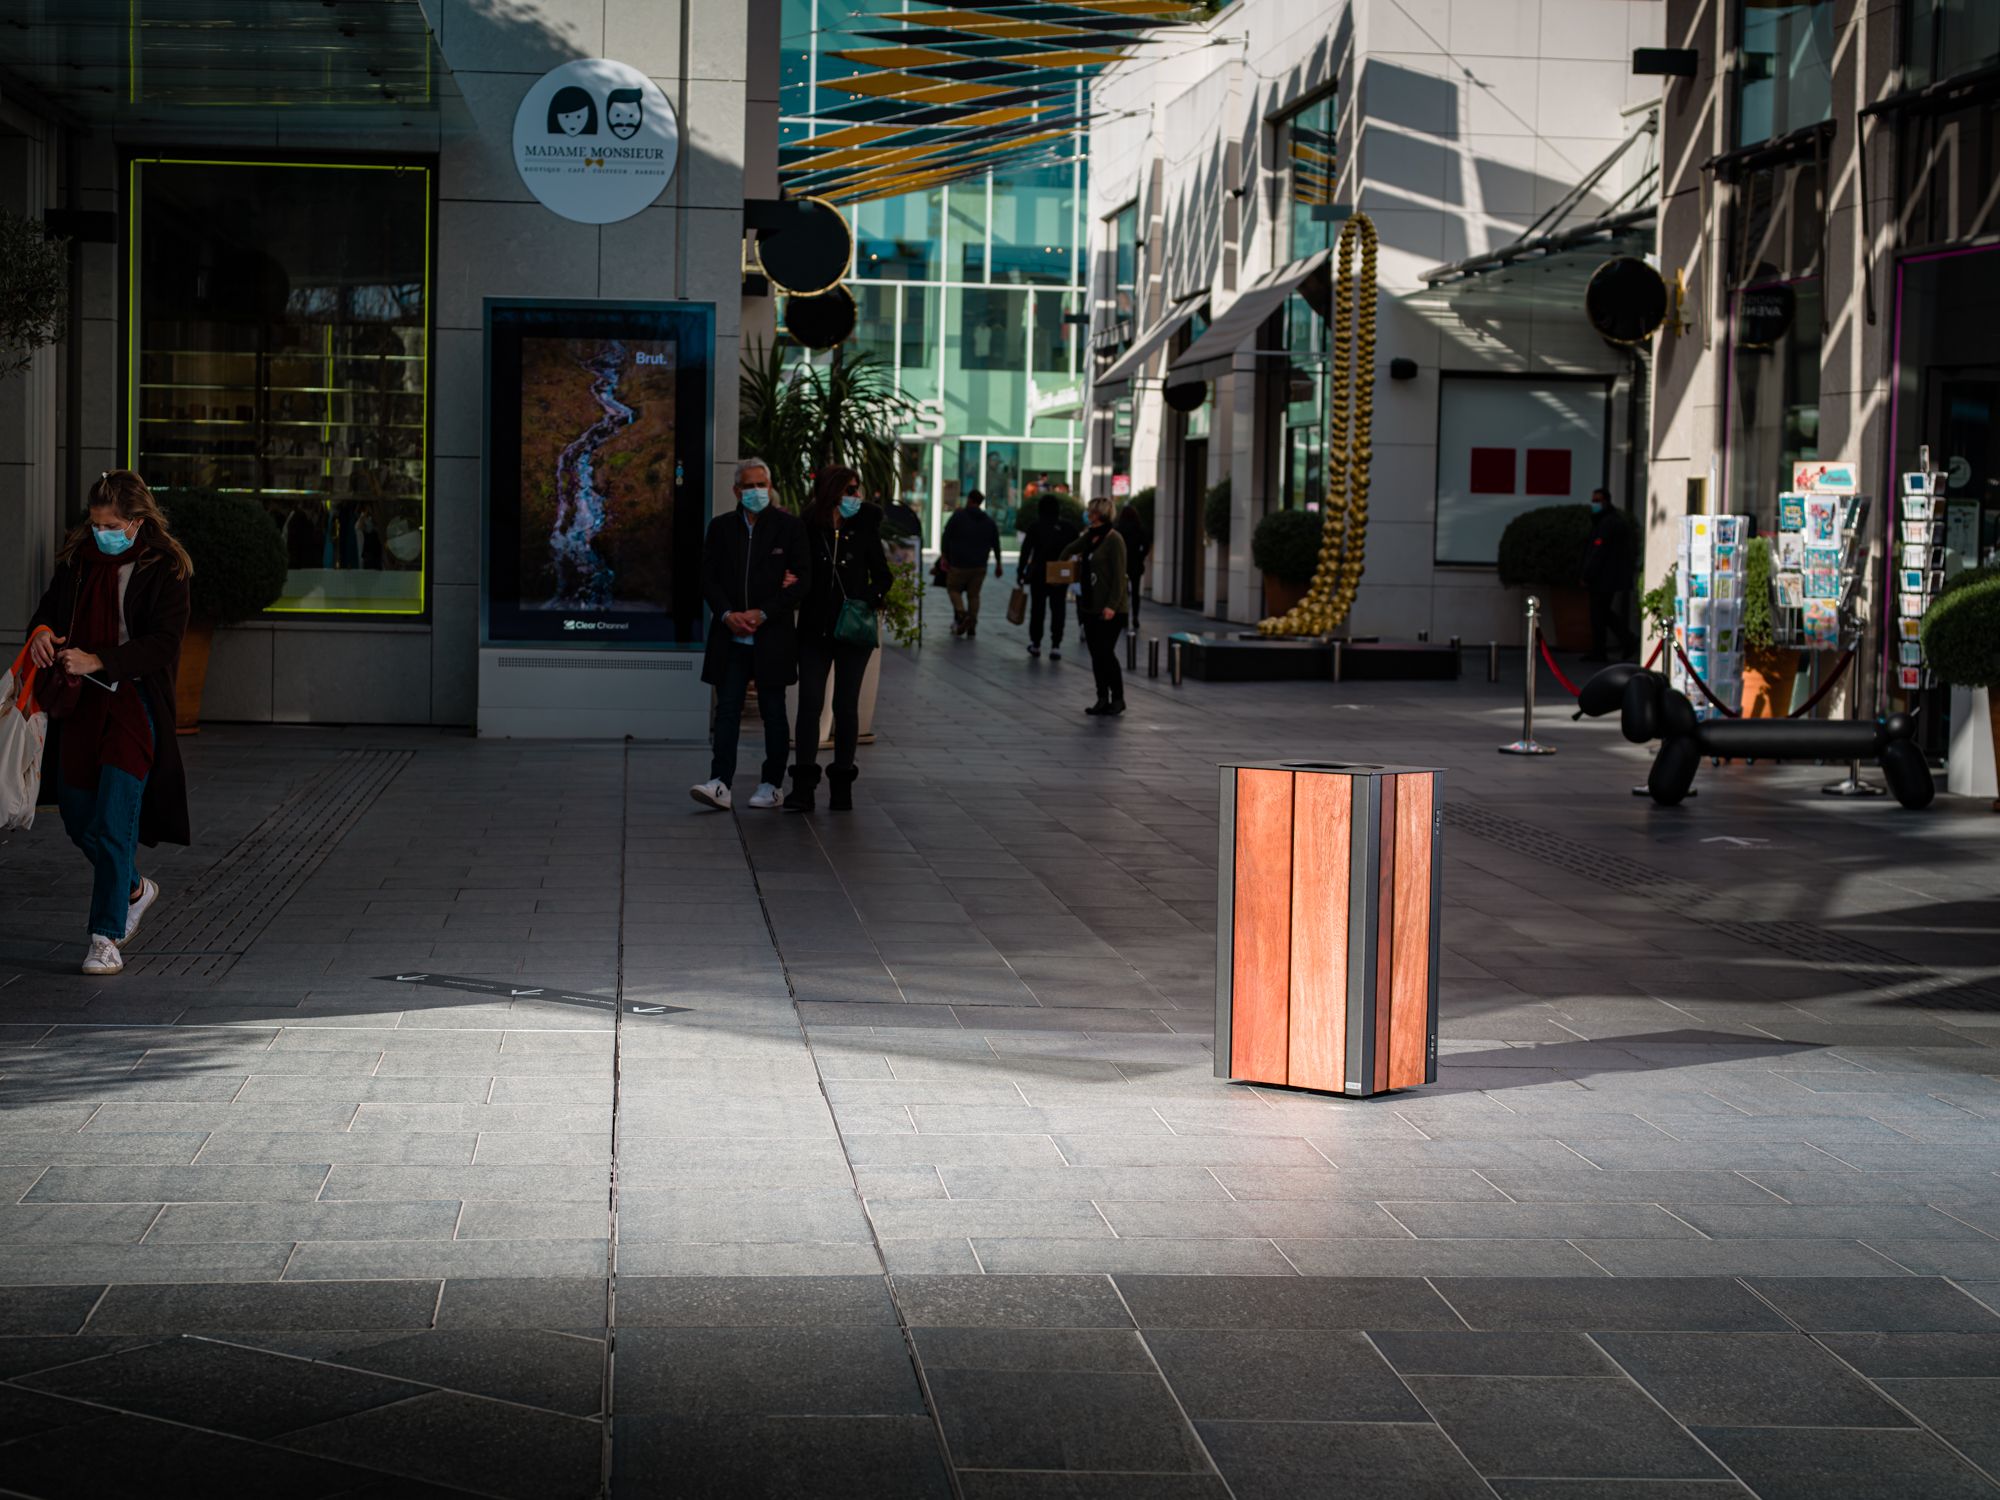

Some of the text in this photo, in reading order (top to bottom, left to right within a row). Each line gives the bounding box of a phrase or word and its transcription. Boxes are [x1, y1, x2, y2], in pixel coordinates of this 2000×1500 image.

[525, 145, 664, 159] MADAME MONSIEUR
[636, 352, 667, 365] Brut.
[575, 621, 629, 629] Clear Channel
